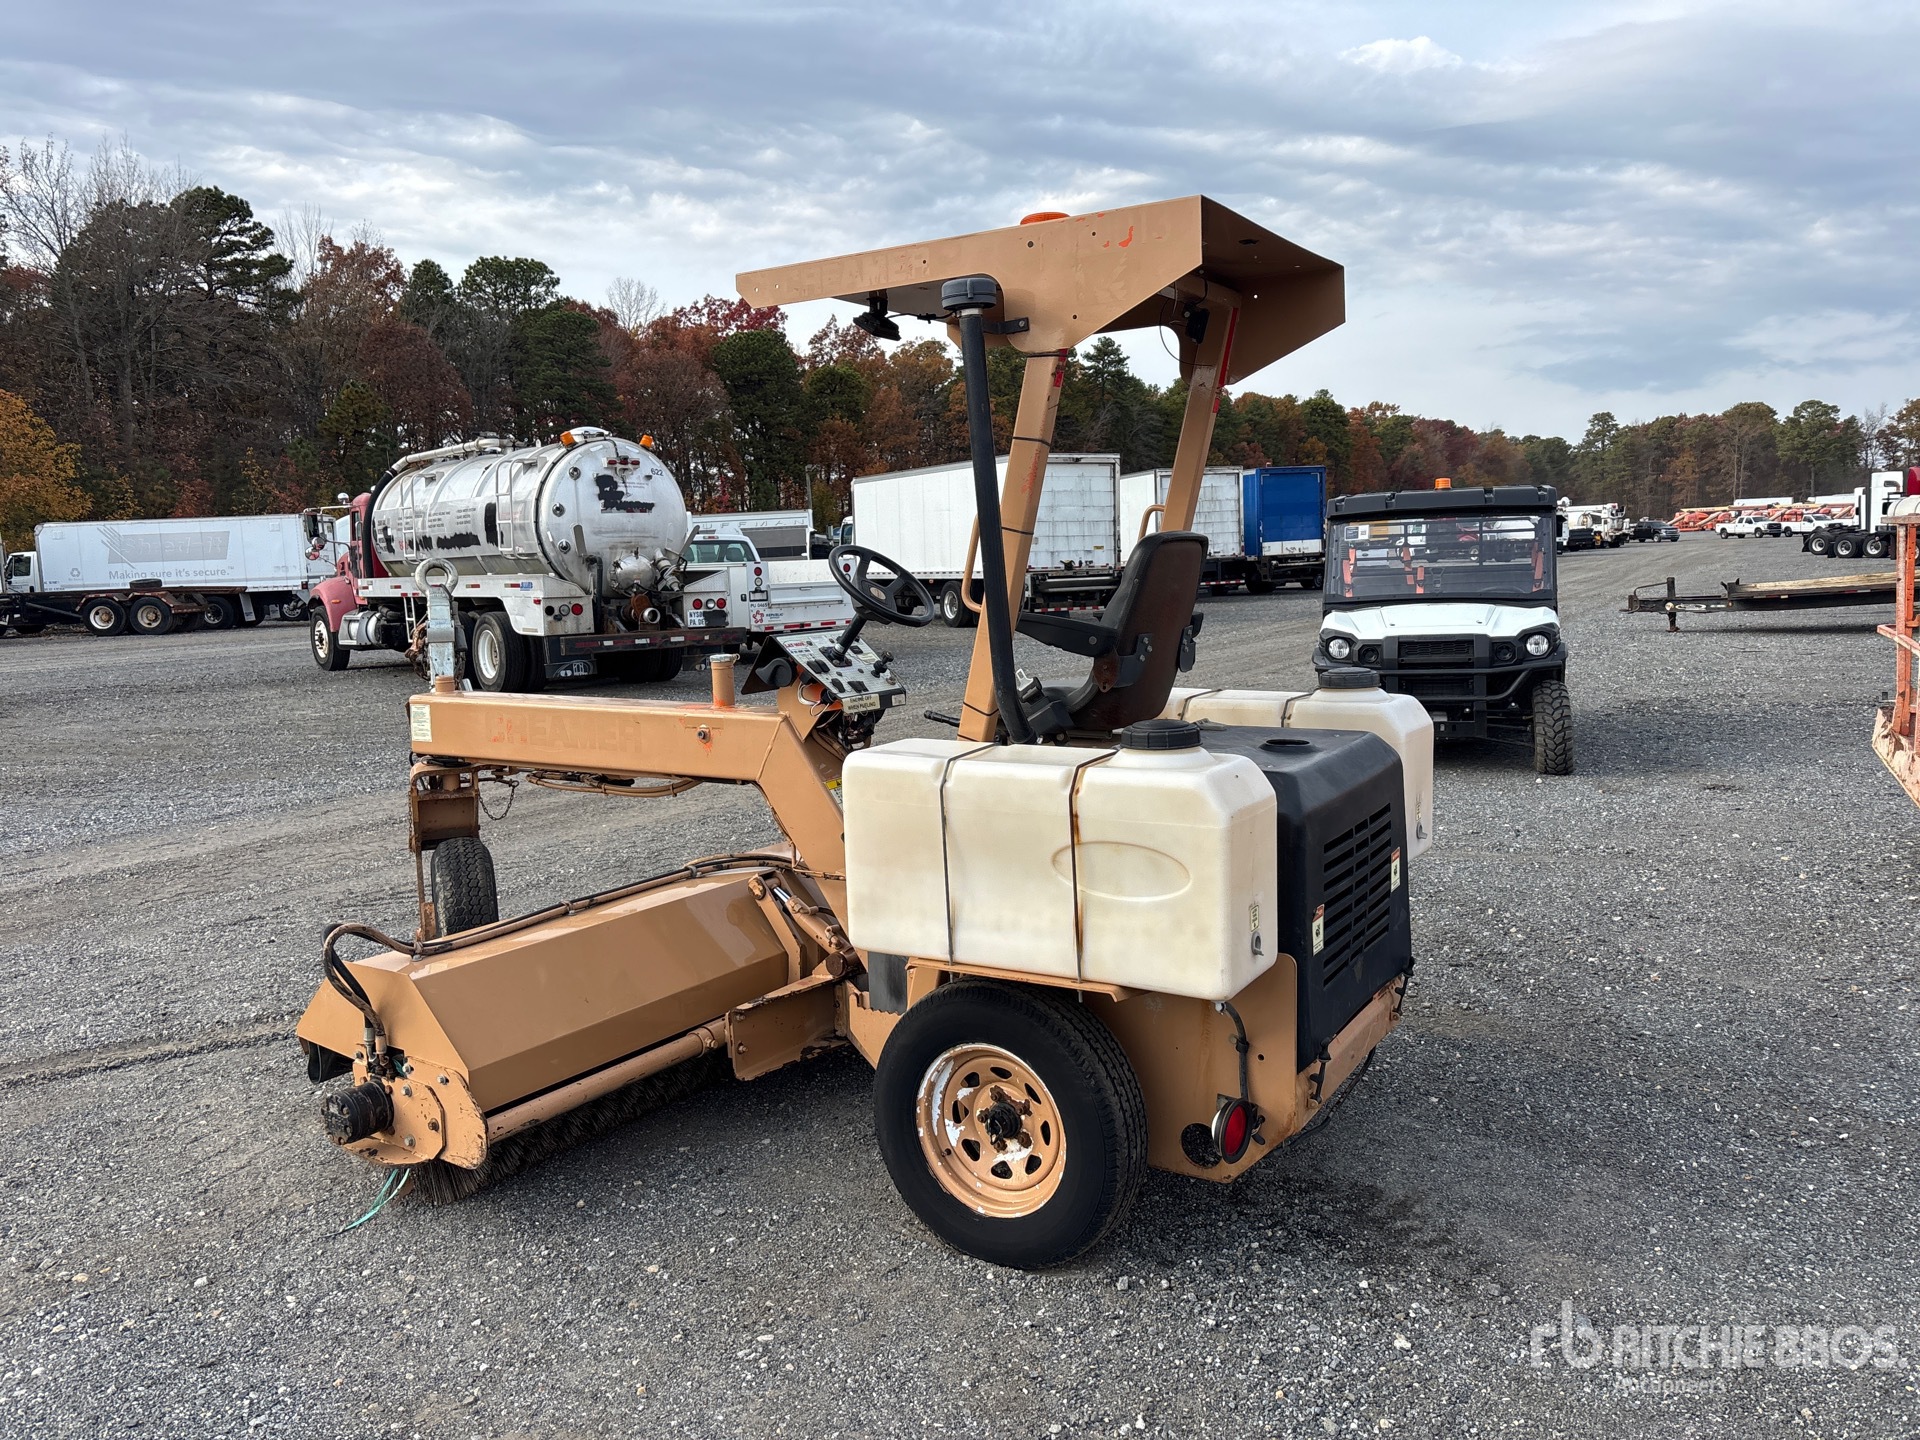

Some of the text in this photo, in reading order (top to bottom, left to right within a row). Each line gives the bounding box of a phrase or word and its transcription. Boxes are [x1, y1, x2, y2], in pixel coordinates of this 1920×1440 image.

[650, 467, 664, 477] 622
[108, 570, 147, 580] Making
[150, 570, 173, 579] sure
[175, 568, 190, 578] it's
